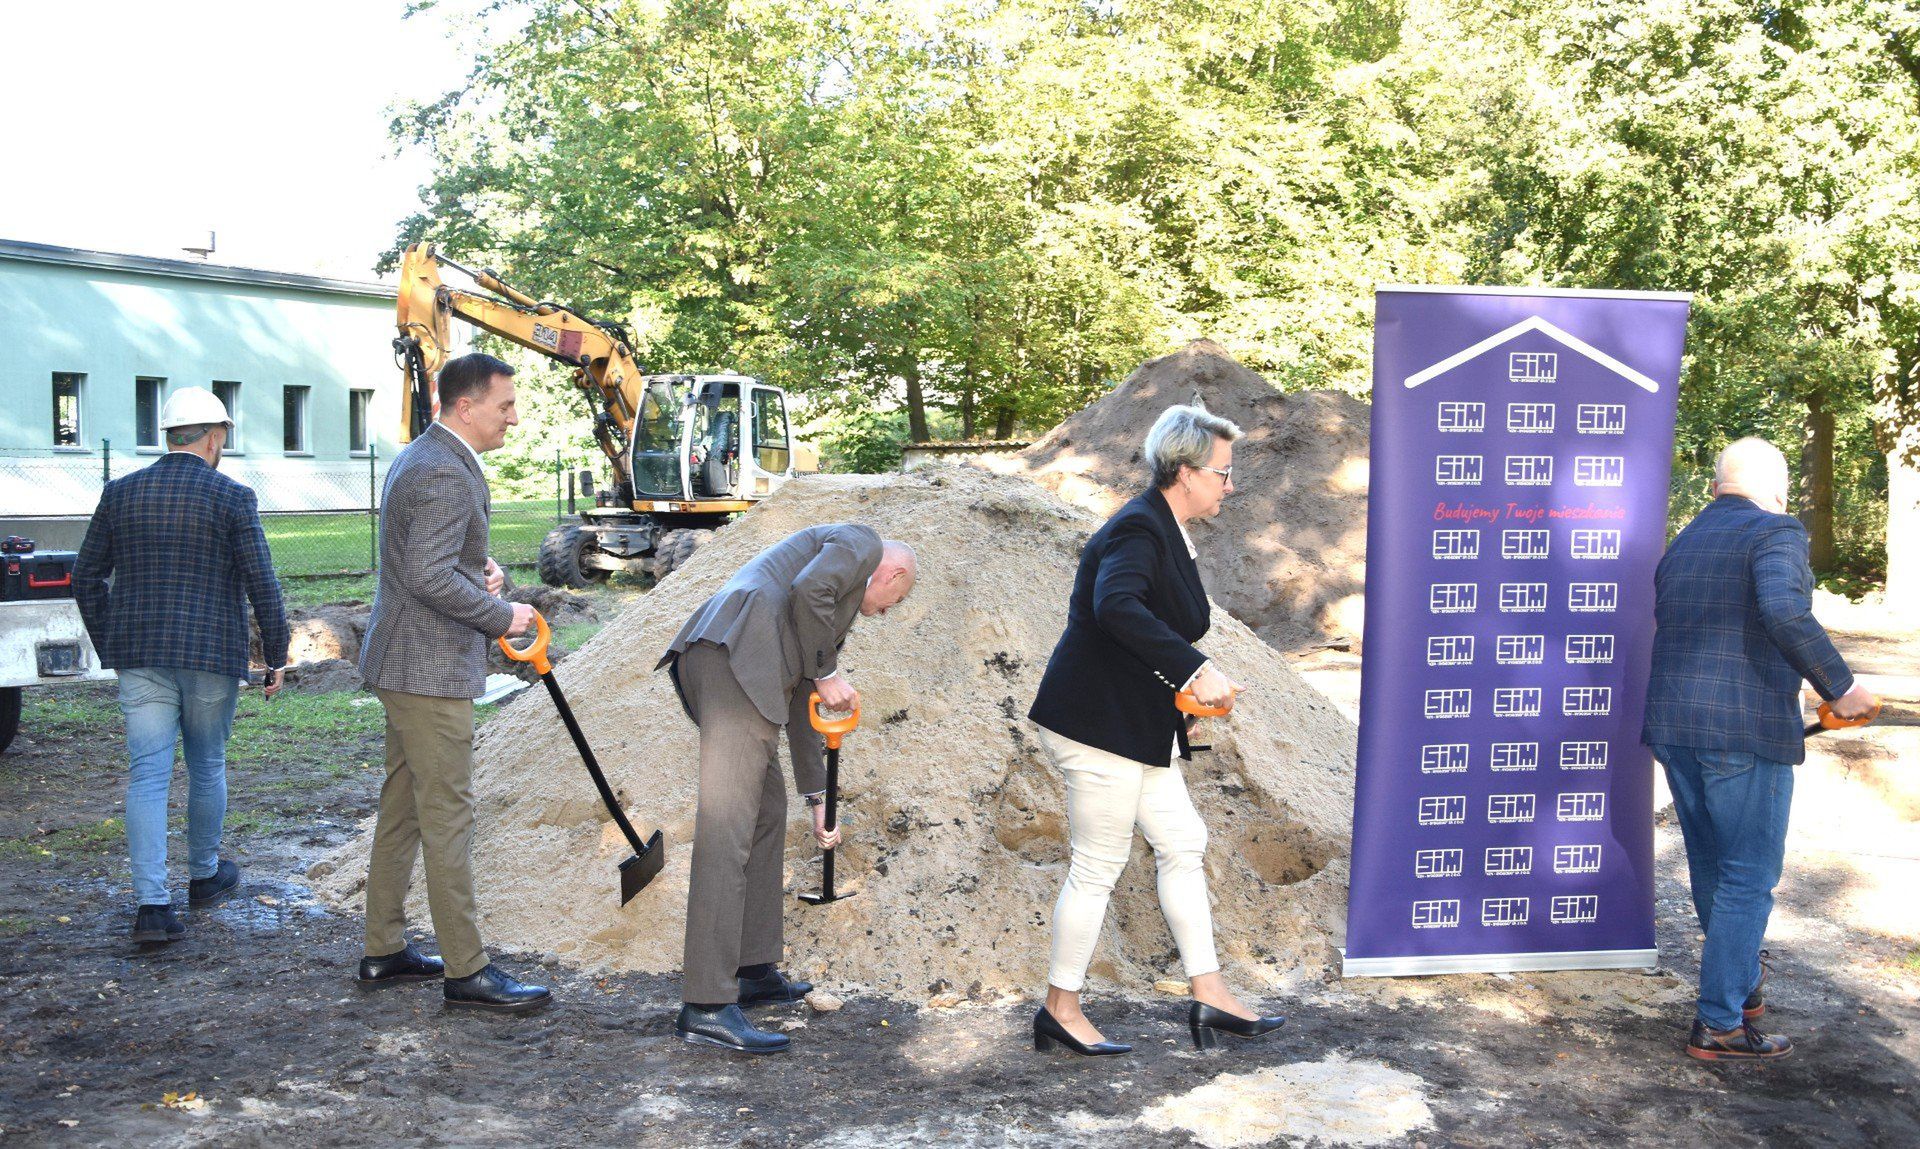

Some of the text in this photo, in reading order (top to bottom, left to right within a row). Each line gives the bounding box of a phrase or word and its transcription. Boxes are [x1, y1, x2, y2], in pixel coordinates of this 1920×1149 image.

[1434, 502, 1626, 524] Budujemy Twoje mieszkanie
